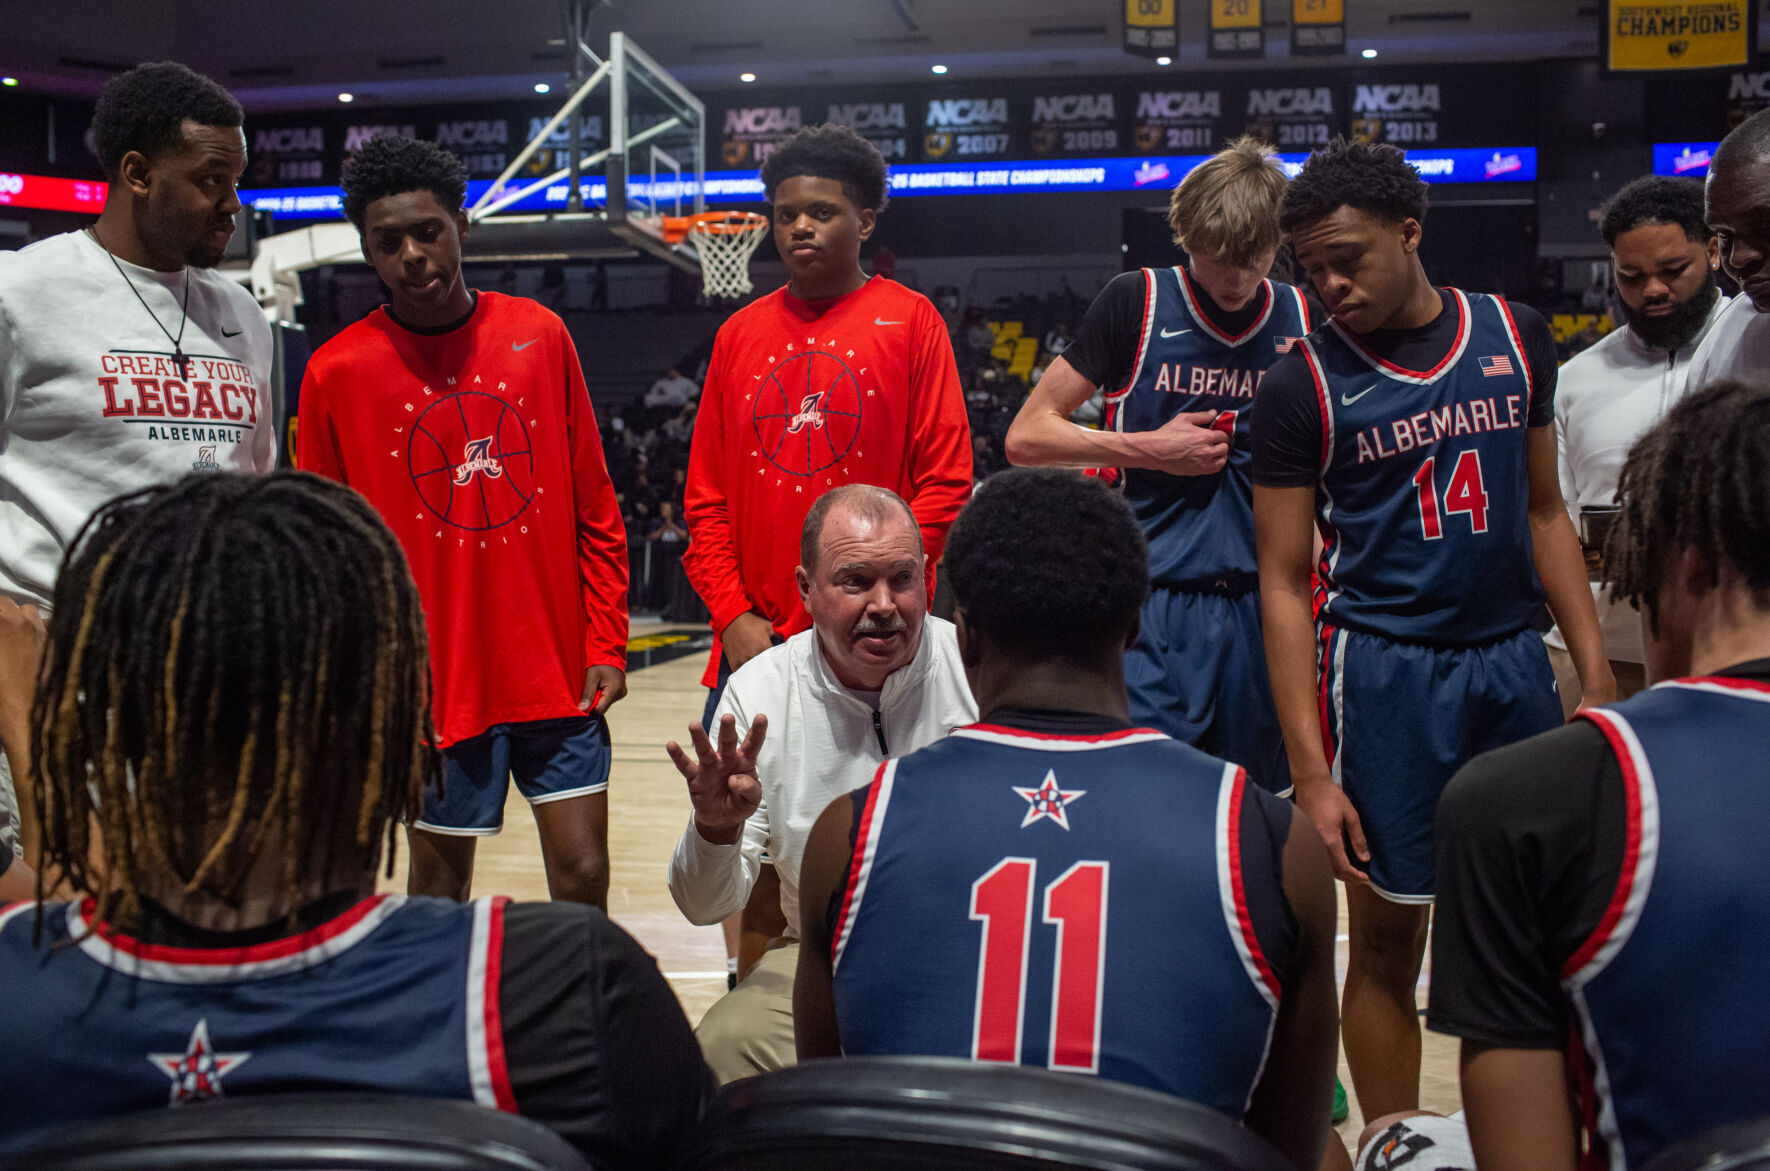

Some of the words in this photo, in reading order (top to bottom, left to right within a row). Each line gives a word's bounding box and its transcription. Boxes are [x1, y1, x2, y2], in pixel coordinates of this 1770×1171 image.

[1618, 5, 1683, 16] SOUTHWEST
[1687, 2, 1740, 14] REGIONAL
[1617, 13, 1740, 36] CHAMPIONS
[1353, 84, 1440, 112] NCAA
[1729, 72, 1770, 99] NC
[926, 98, 1008, 126] NCAA
[1032, 94, 1115, 122] NCAA
[1137, 91, 1221, 117] NCAA
[1247, 88, 1333, 114] NCAA
[723, 107, 800, 135] NCAA
[826, 104, 906, 128] NCAA
[254, 127, 324, 152] NCAA
[436, 120, 508, 147] NCAA
[956, 134, 1010, 154] 2007
[1063, 130, 1117, 151] 2009
[1166, 128, 1212, 148] 2011
[1279, 124, 1329, 145] 2012
[1386, 121, 1437, 142] 2013
[909, 171, 975, 189] BASKETBALL
[975, 170, 1010, 187] STATE
[1010, 167, 1106, 185] CHAMPIONSHIPS
[101, 355, 198, 379] CREATE
[201, 360, 253, 385] YOUR
[745, 337, 876, 401] ALBEMARLE
[1154, 362, 1266, 399] ALBEMA
[98, 376, 258, 425] LEGACY
[390, 375, 538, 458] ALBEMARLE
[1356, 394, 1521, 465] ALBEMARLE
[148, 426, 242, 444] ALBEMARLE
[750, 450, 863, 493] PATROTS
[1412, 448, 1490, 541] 14
[415, 486, 545, 549] PATRIOS
[968, 856, 1110, 1075] 11
